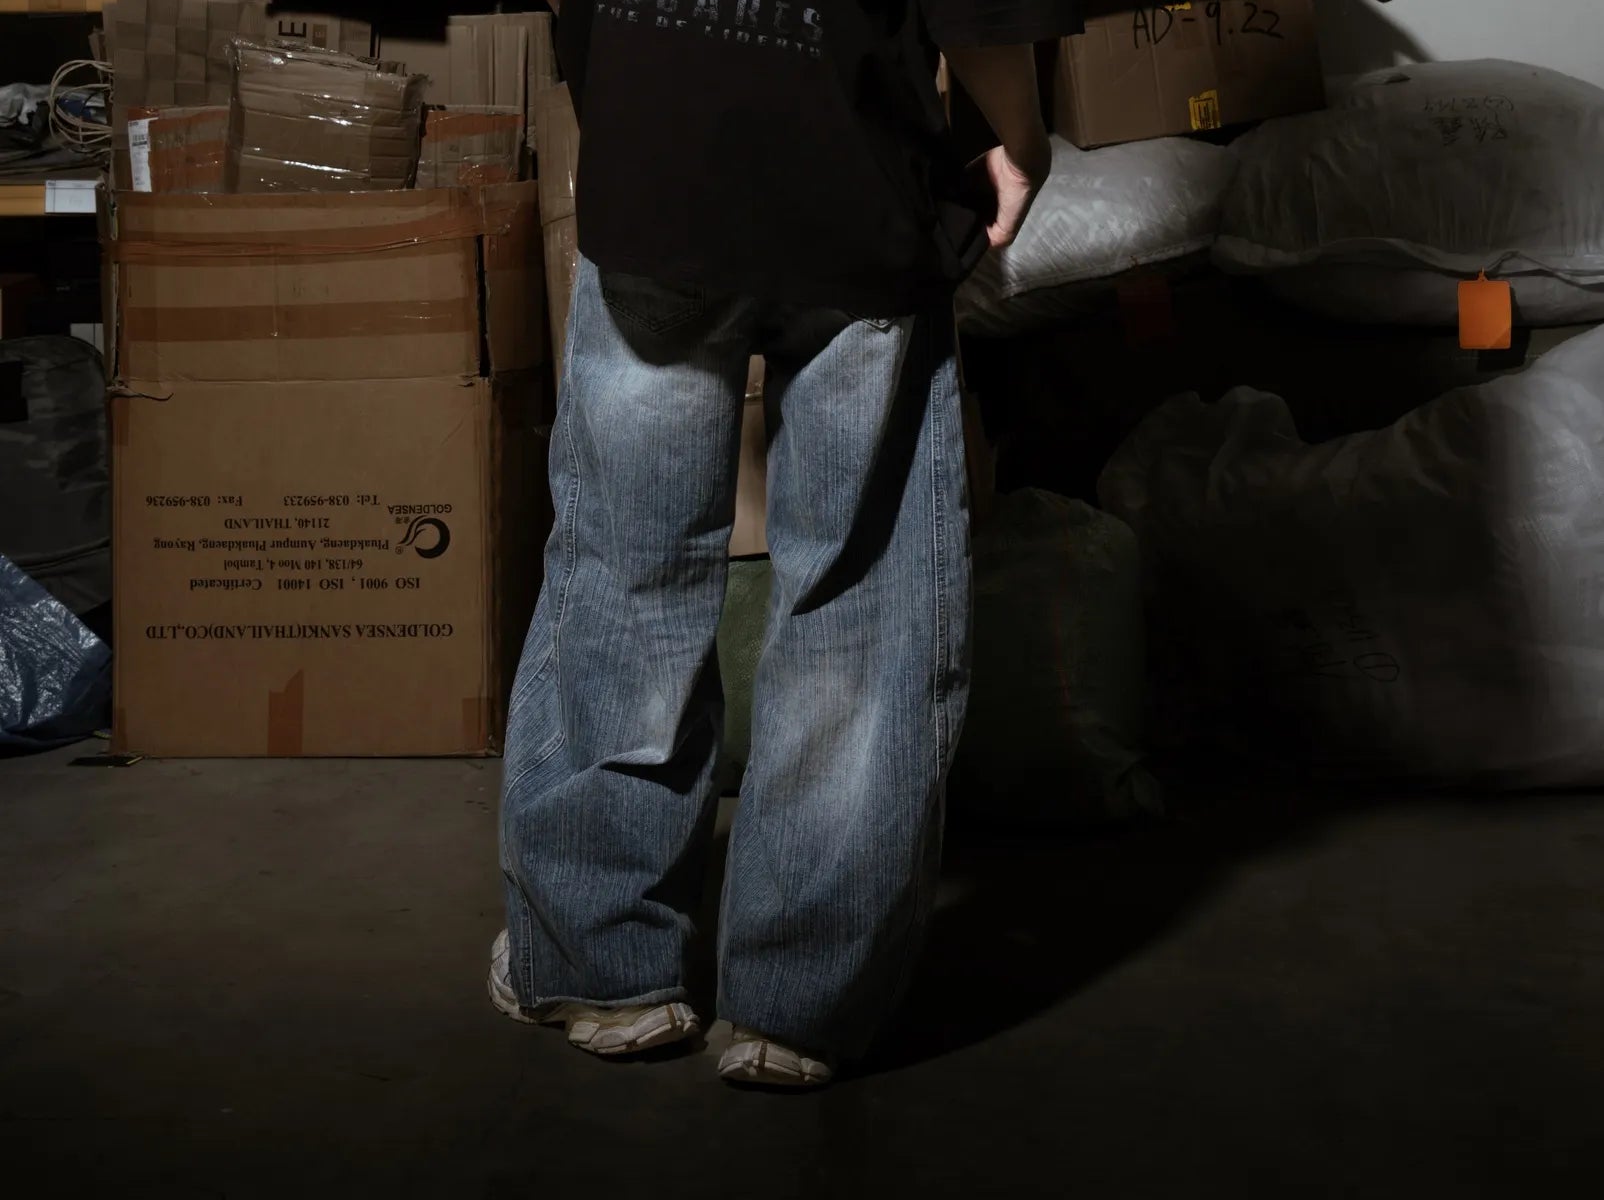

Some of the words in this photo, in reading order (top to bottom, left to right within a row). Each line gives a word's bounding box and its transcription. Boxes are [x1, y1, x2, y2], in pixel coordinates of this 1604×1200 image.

[145, 495, 211, 507] 038-959236
[217, 495, 244, 507] Fax:
[282, 495, 350, 507] 038-959233
[356, 494, 381, 506] Tel:
[387, 503, 453, 515] GOLDENSEA
[224, 517, 293, 530] THAILAND
[294, 517, 331, 529] 21140,
[153, 537, 196, 552] Rayong
[198, 537, 267, 552] Pluakdaeng,
[269, 537, 317, 551] Aumpur
[319, 537, 390, 551] Pluakdaeng,
[223, 559, 264, 571] Tambol
[278, 559, 301, 571] Moo
[304, 559, 322, 570] 140
[325, 558, 363, 571] 64/138,
[189, 578, 263, 591] Certificated
[277, 578, 311, 590] 14001
[319, 578, 344, 591] ISO
[395, 577, 421, 590] ISO
[356, 623, 454, 638] GOLDENSEA
